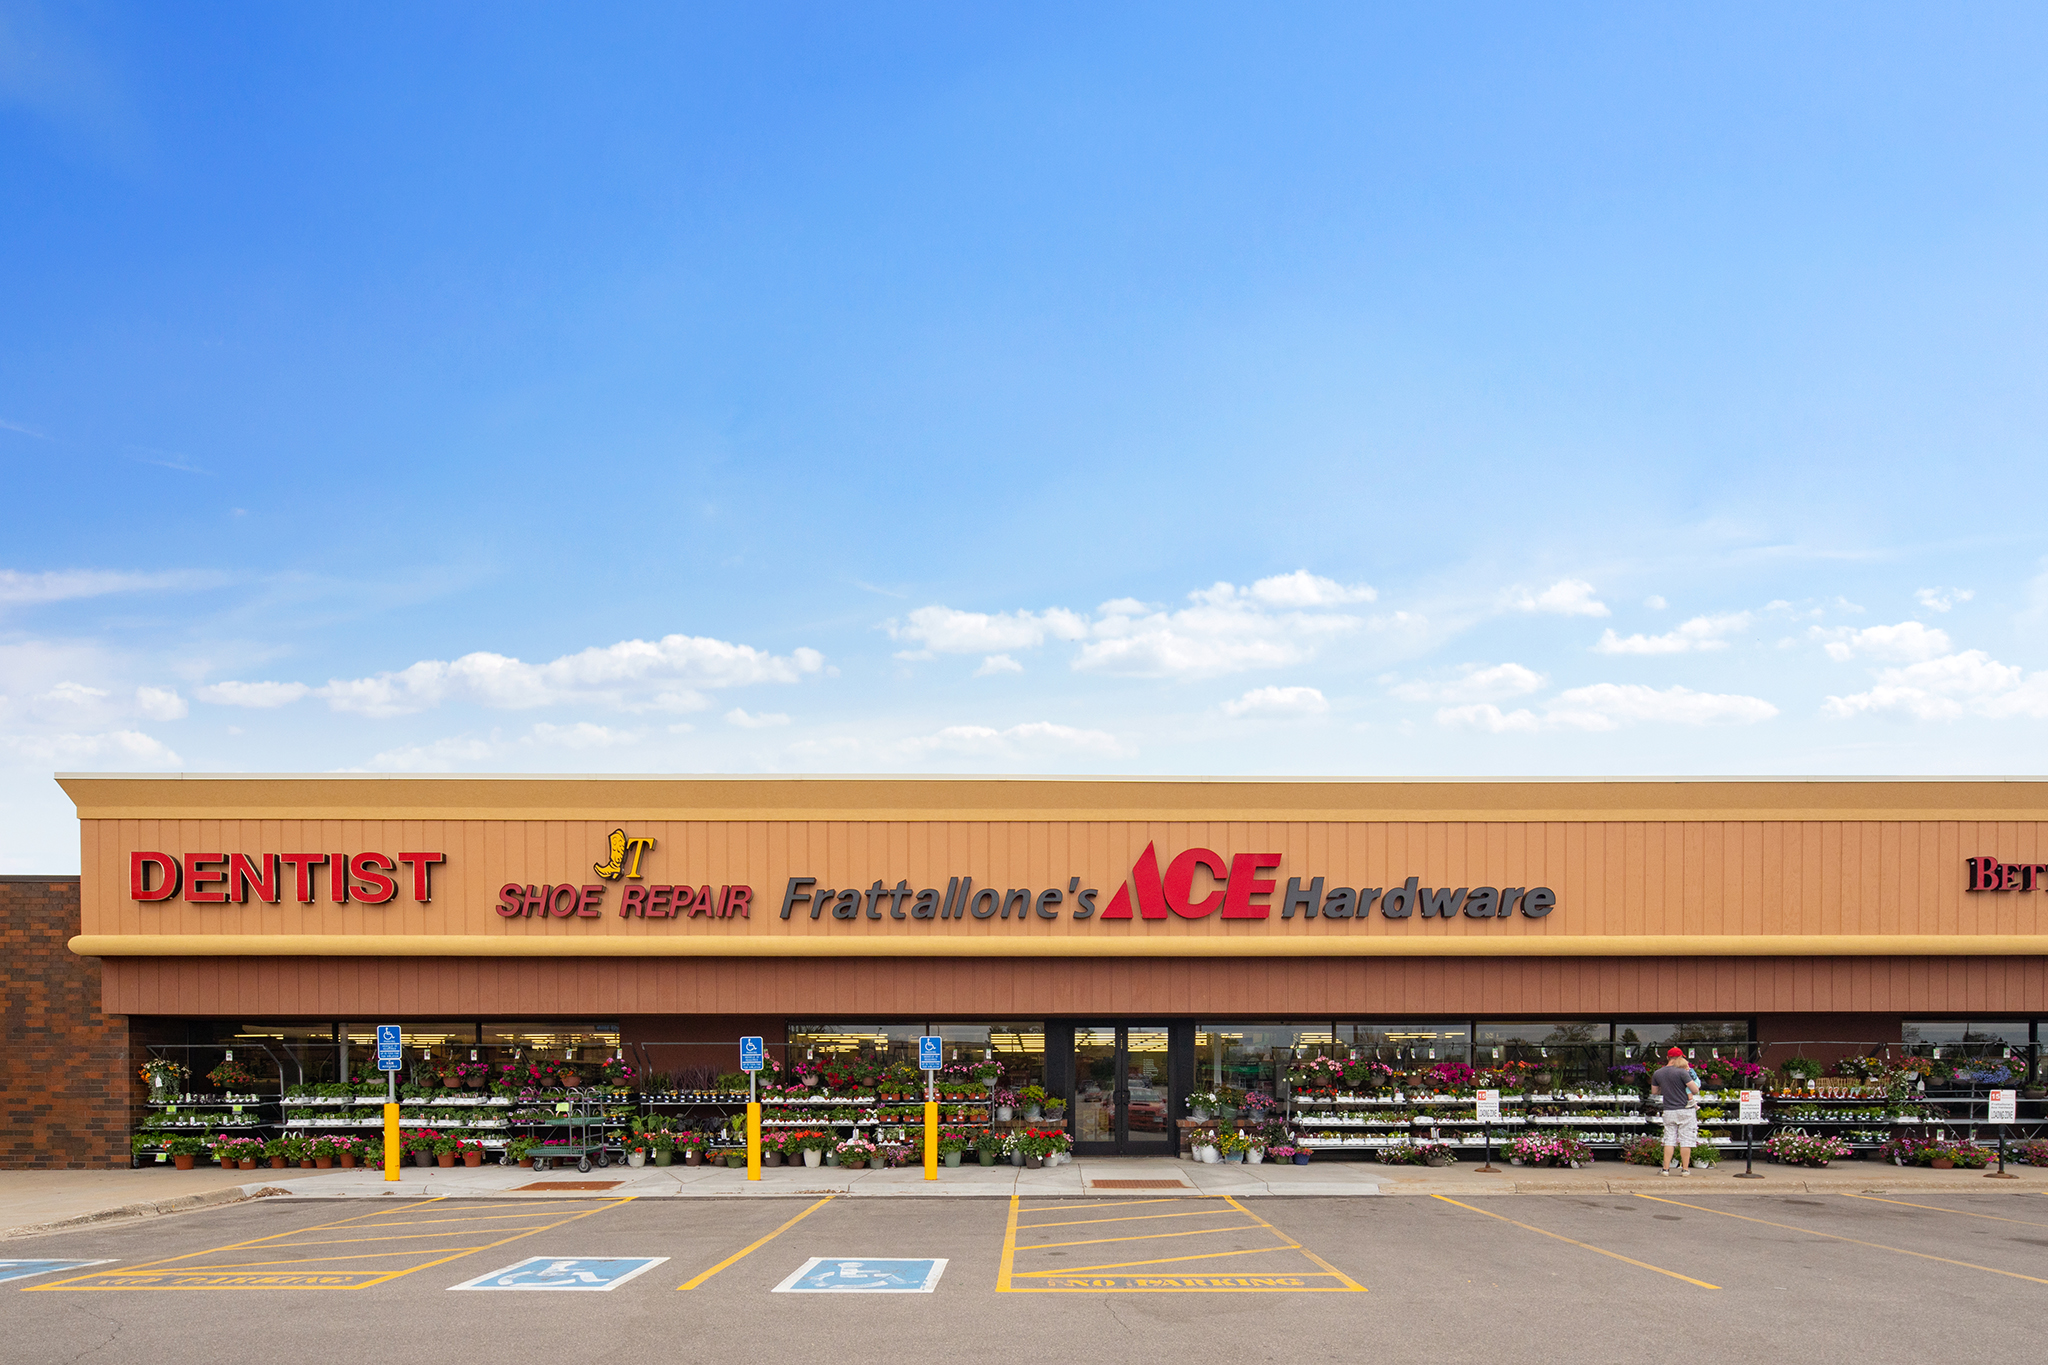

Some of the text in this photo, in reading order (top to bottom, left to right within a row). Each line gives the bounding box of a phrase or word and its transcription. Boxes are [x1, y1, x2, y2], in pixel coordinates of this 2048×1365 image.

[130, 851, 446, 903] DENTIST
[779, 839, 1556, 920] Frattallone's ACE Hardware
[1965, 856, 2048, 892] BET
[496, 883, 753, 918] SHOE REPAIR
[1065, 1278, 1305, 1287] NO PARKING
